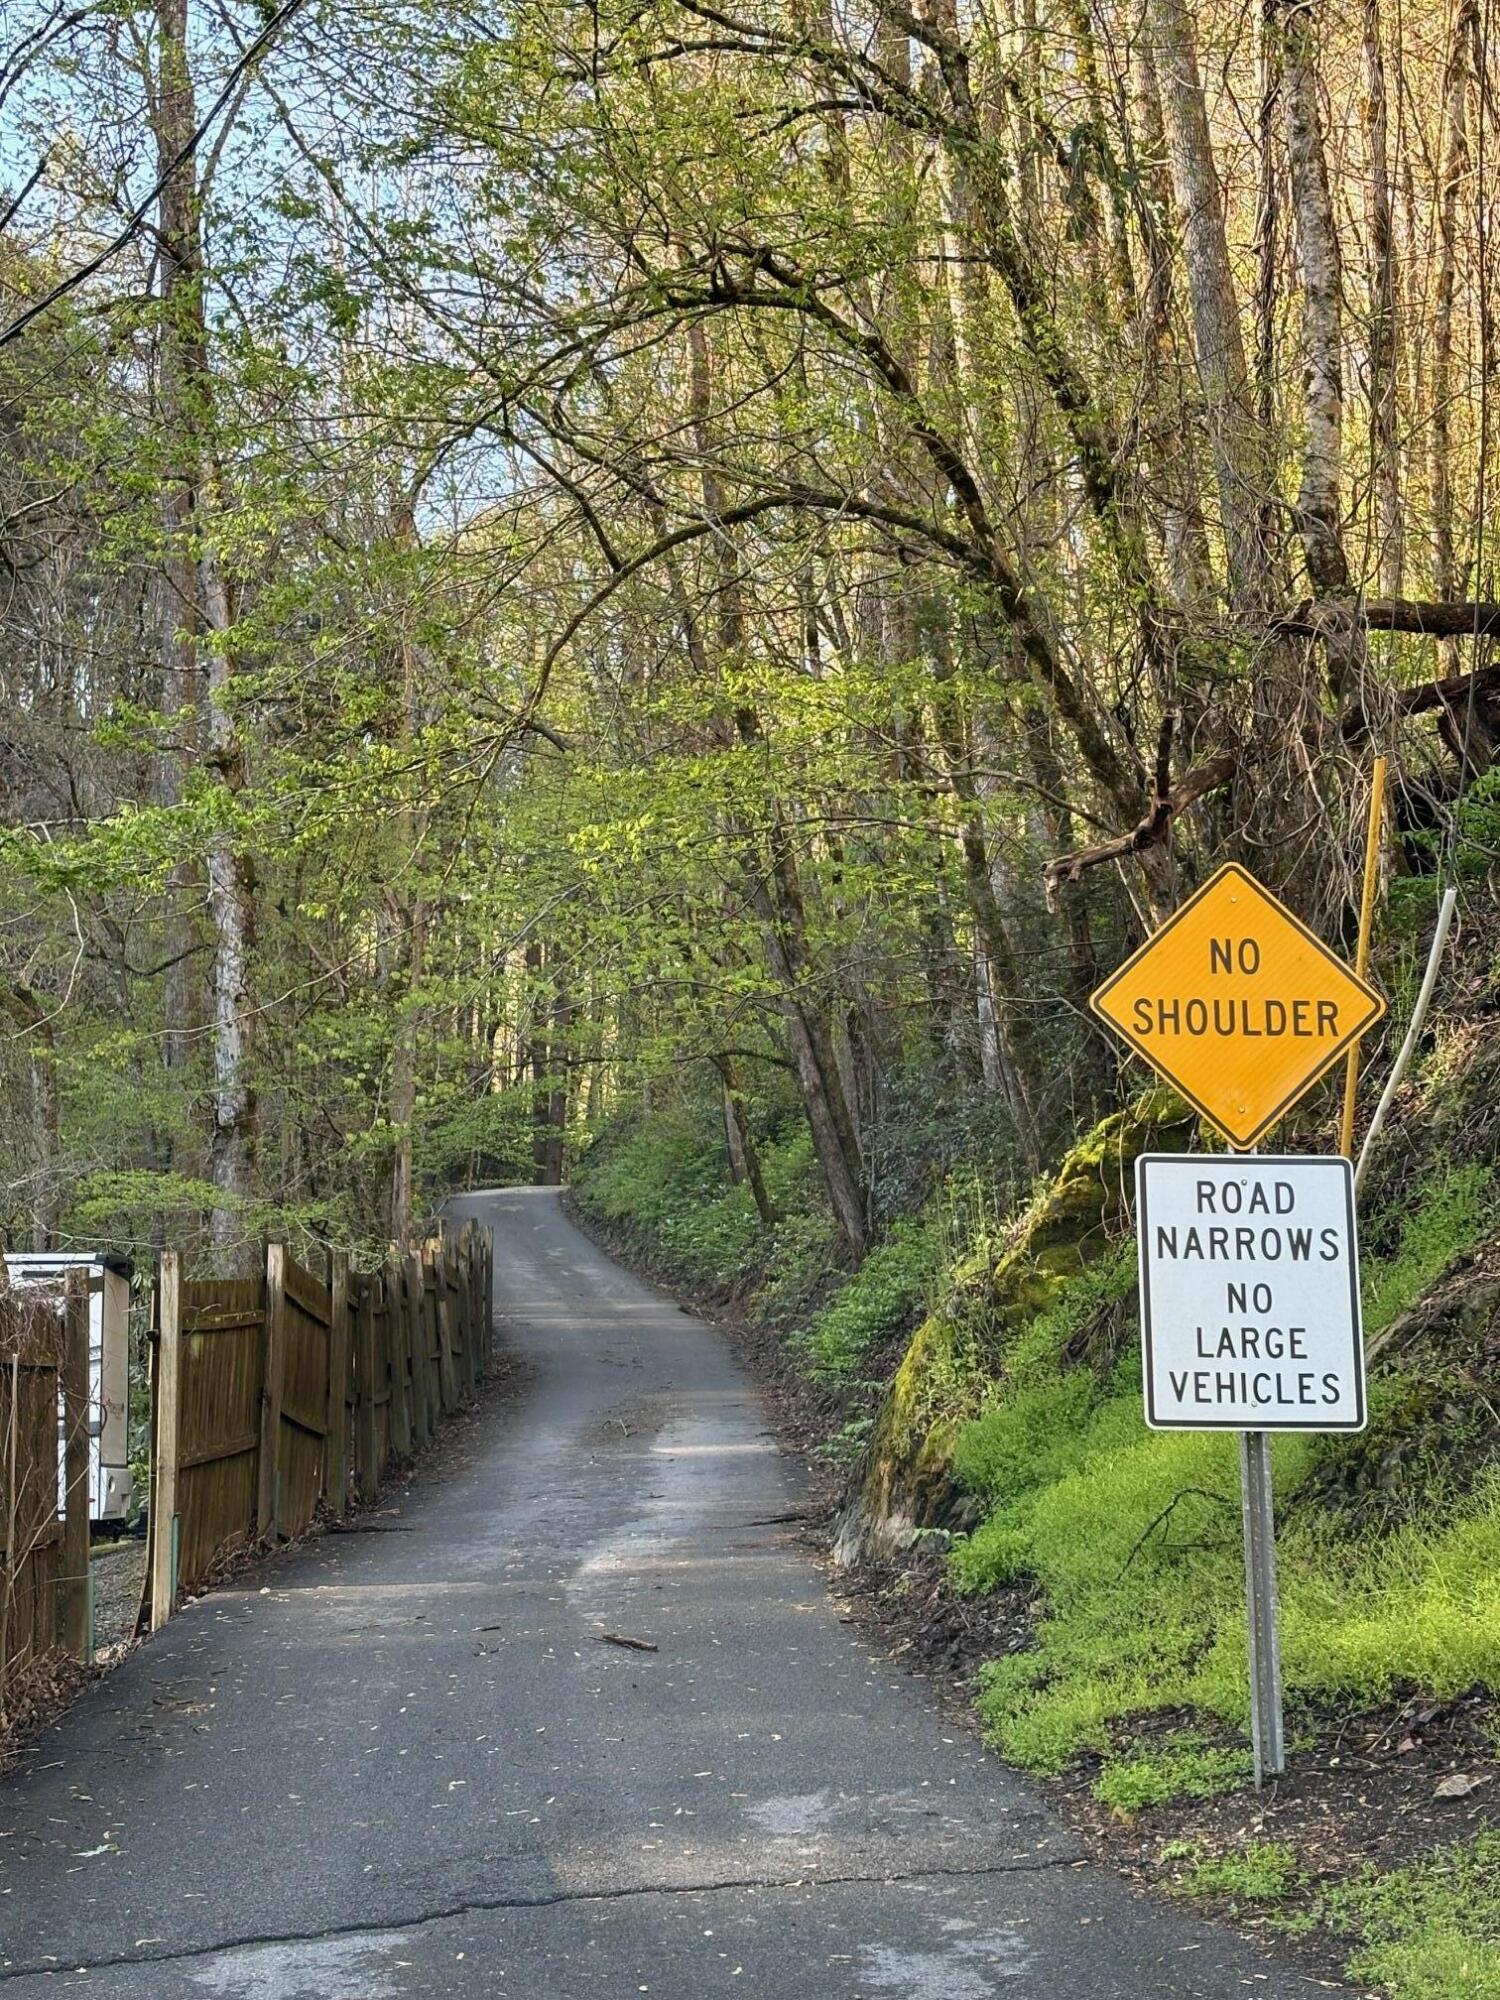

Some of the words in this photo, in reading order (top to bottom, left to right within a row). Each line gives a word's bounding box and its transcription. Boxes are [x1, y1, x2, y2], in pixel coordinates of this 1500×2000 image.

[1210, 938, 1261, 975] NO
[1132, 998, 1339, 1037] SHOULDER
[1196, 1180, 1295, 1215] ROAD
[1157, 1226, 1340, 1262] NARROWS
[1227, 1282, 1273, 1314] NO
[1196, 1326, 1308, 1360] LARGE
[1169, 1371, 1341, 1405] VEHICLES
